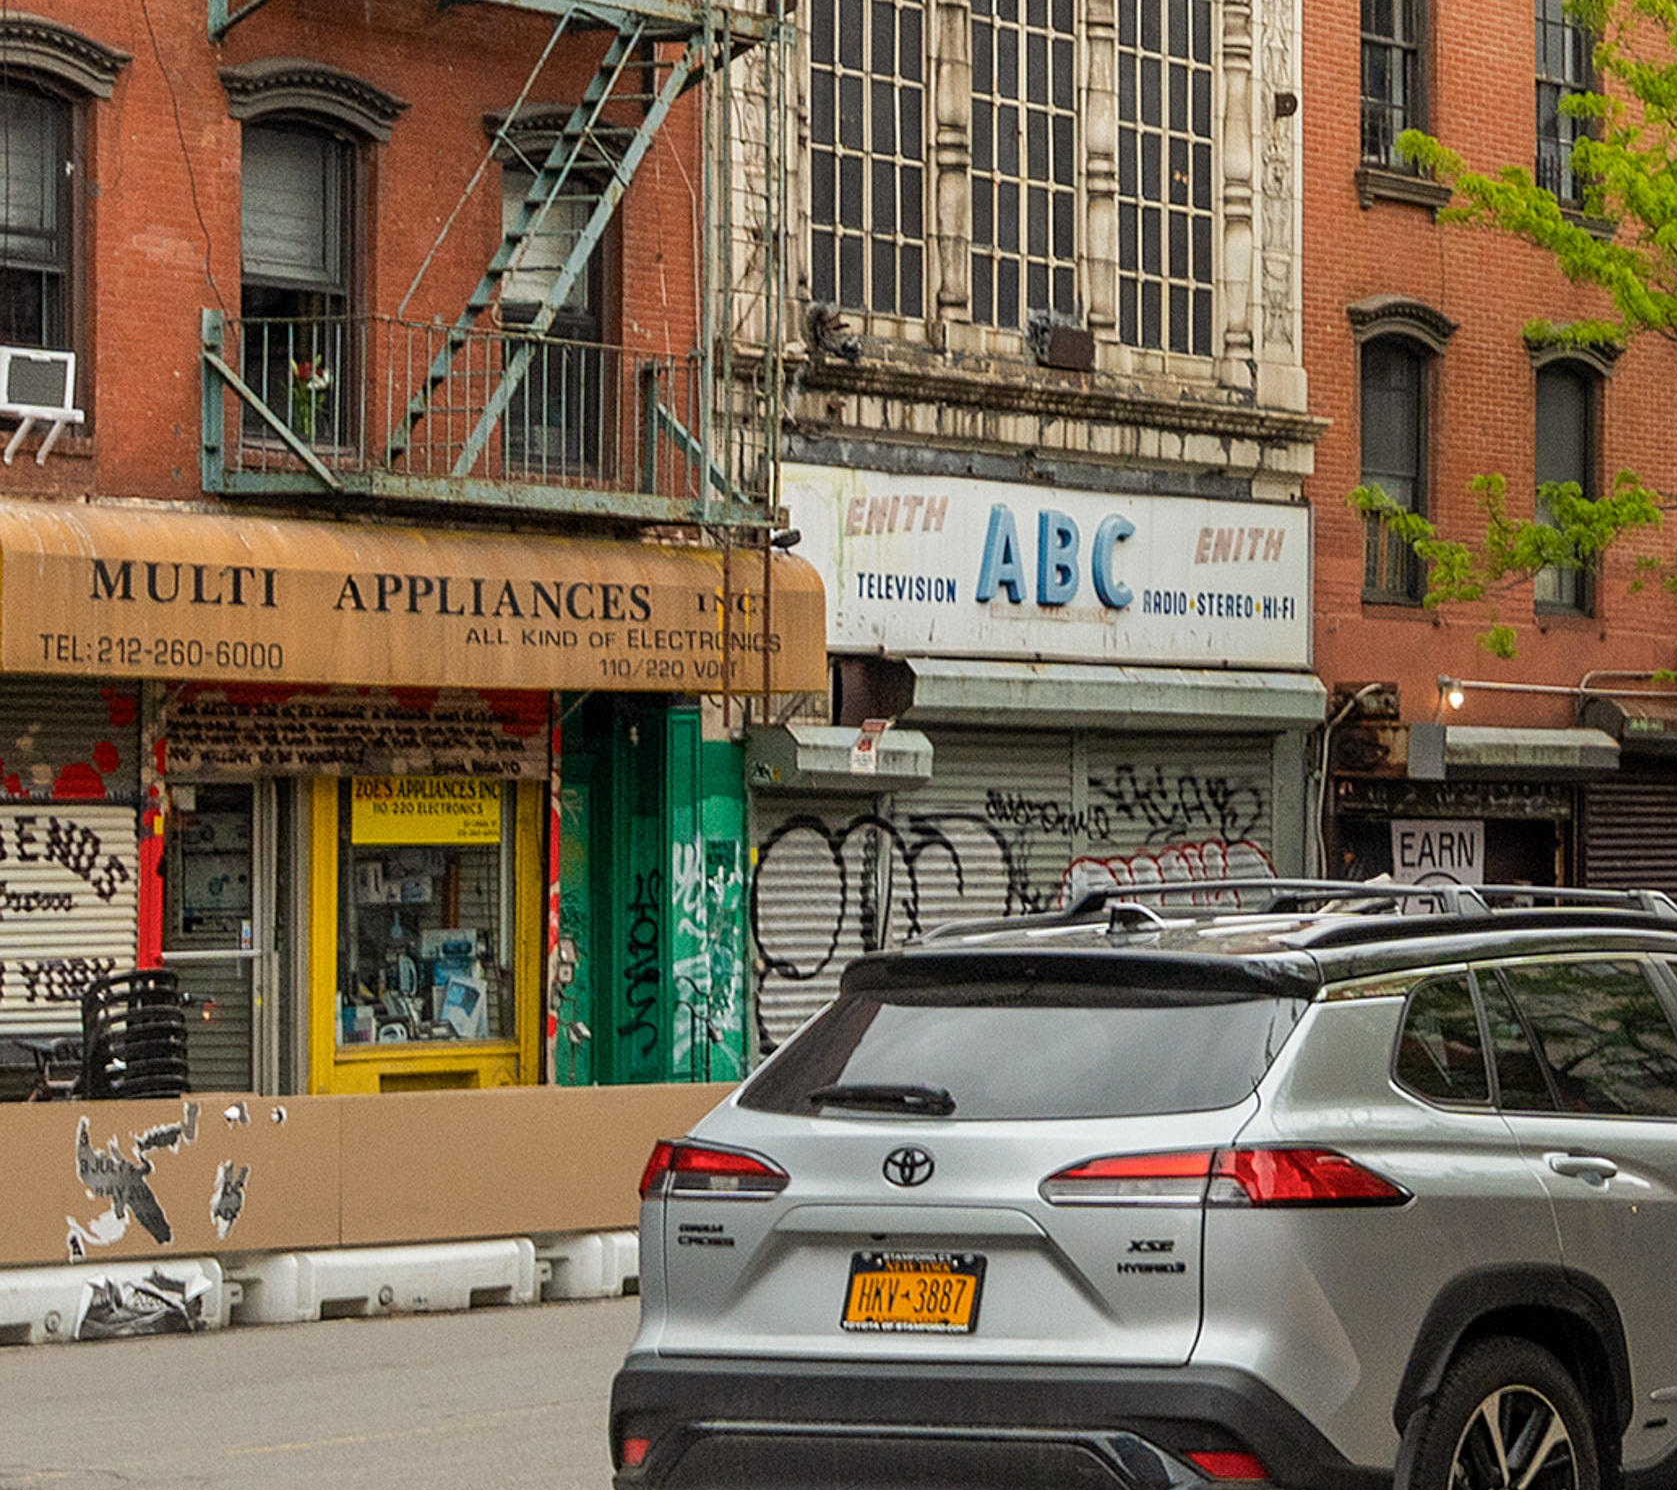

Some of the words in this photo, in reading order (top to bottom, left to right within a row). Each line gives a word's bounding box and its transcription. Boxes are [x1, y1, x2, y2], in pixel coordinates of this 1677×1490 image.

[844, 495, 950, 537] ENITH
[975, 503, 1136, 610] ABC
[1193, 527, 1286, 565] ENITH
[90, 559, 280, 608] MULTI
[333, 573, 652, 622] APPLIANCES
[856, 572, 957, 604] TELEVISION
[1143, 589, 1187, 616] RADIO
[1196, 591, 1254, 618] STEREO
[1262, 596, 1296, 621] HI-FI
[466, 628, 509, 646] ALL
[521, 629, 578, 649] KIND
[588, 631, 616, 649] OF
[627, 628, 783, 654] ELECTRONICS
[598, 658, 684, 679] 110/220
[355, 779, 393, 798] ZOE'S
[396, 779, 476, 799] APPLIANCES
[479, 779, 500, 799] INC
[417, 802, 484, 815] ELECTRONICS
[1400, 831, 1474, 868] EARN
[1126, 1240, 1175, 1253] XSE
